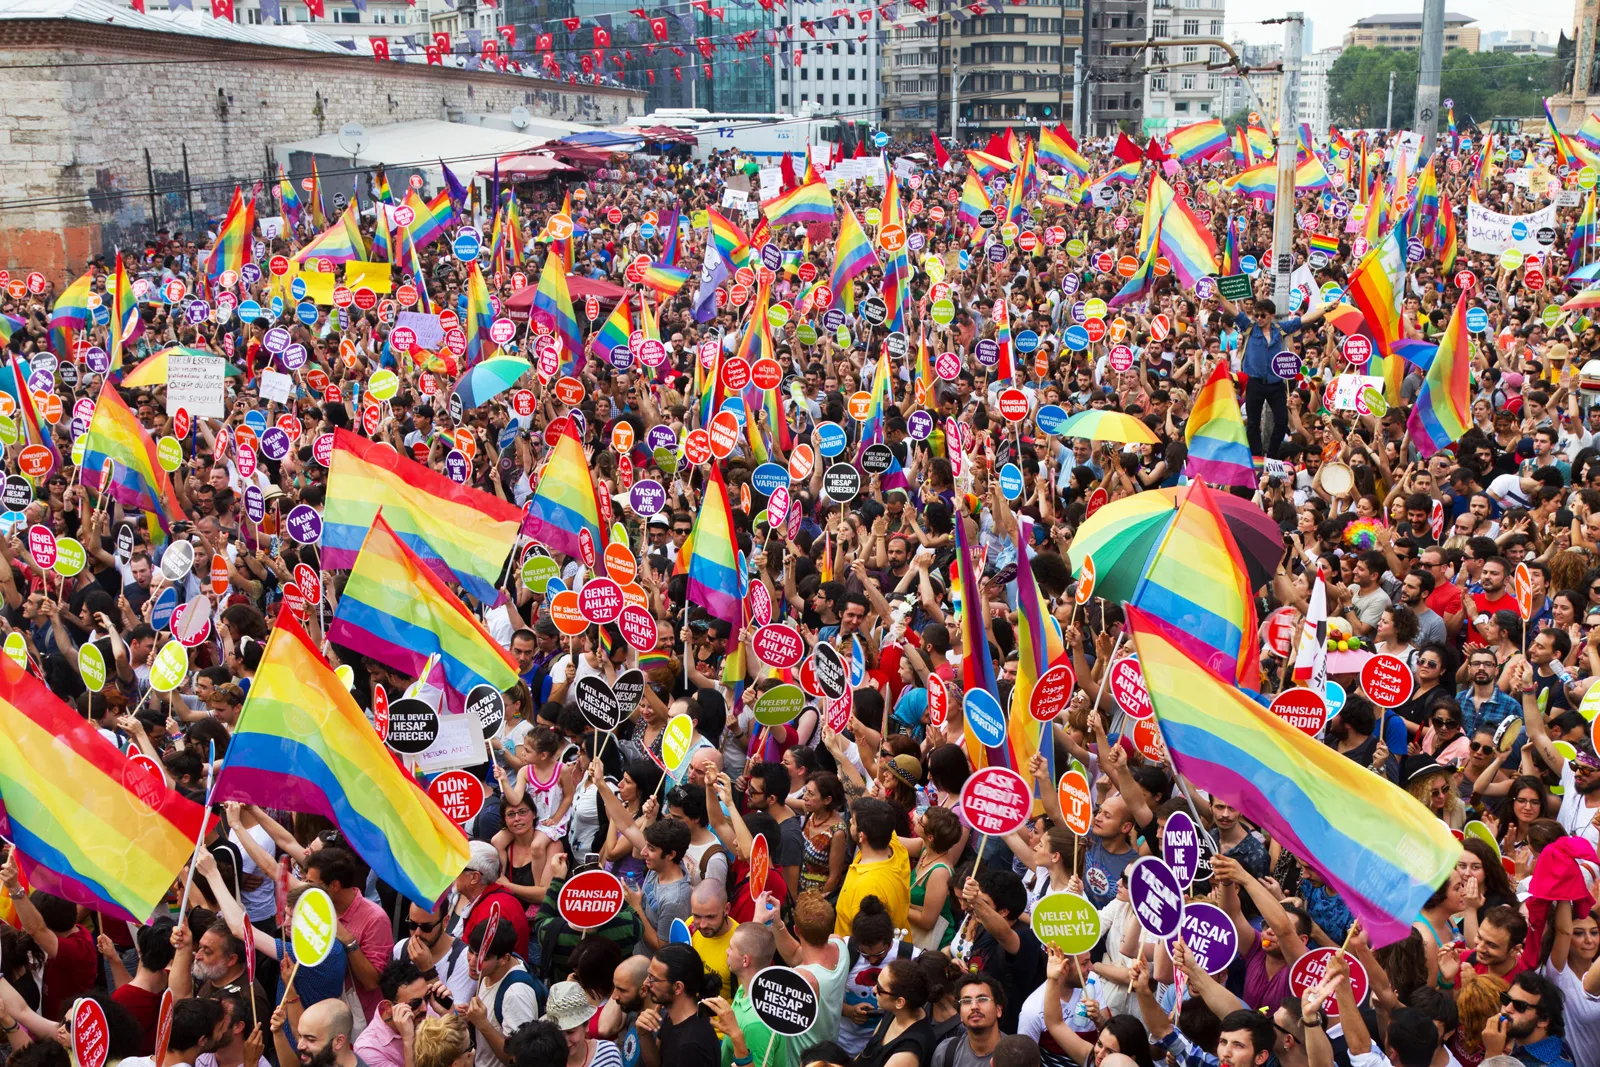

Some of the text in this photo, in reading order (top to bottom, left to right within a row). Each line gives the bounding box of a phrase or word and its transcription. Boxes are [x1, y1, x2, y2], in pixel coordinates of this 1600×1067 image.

[718, 128, 734, 138] T2
[652, 430, 674, 442] YASAK
[712, 421, 737, 438] TRANSLAR
[264, 431, 284, 445] YASAK
[711, 430, 735, 450] VARDIR
[273, 448, 285, 458] AYOL
[635, 488, 661, 497] YASAK
[289, 511, 315, 527] YASAK
[301, 523, 310, 533] NE
[32, 532, 51, 541] GENEL
[302, 532, 318, 541] AYOL
[33, 543, 54, 552] AHLAK-
[37, 555, 50, 564] SIZ!
[584, 586, 617, 599] GENEL
[585, 596, 620, 610] AHLAK-
[592, 609, 612, 619] SIZ!
[624, 612, 651, 628] GENEL
[624, 622, 654, 640] AHLAK-
[630, 635, 647, 648] SIZ!
[763, 629, 796, 649] GENEL
[758, 638, 797, 658] AHLAK-
[763, 650, 784, 664] SIZ!
[1378, 657, 1401, 672] المثلية
[1374, 668, 1401, 684] موجودة
[580, 681, 616, 708] KATİL POLİS
[584, 690, 610, 712] HESAP
[616, 691, 636, 701] HESAP
[1120, 692, 1141, 714] SIZ!
[1274, 705, 1322, 715] TRANSLAR
[580, 697, 614, 726] VERECEK!
[394, 722, 426, 730] HESAP
[970, 710, 999, 738] VARDIR
[388, 731, 434, 740] VERECEK!
[437, 778, 473, 793] DÖN-
[443, 794, 469, 806] ME-
[442, 806, 470, 820] YİZ!
[1166, 830, 1193, 847] YASAK
[1174, 850, 1185, 864] NE
[566, 889, 618, 899] TRANSLAR
[1140, 864, 1180, 911] YASAK
[565, 900, 615, 912] VARDIR
[1146, 889, 1164, 913] NE
[1040, 908, 1088, 921] VELEV Kİ
[1138, 904, 1162, 934] AYOL
[1039, 922, 1096, 937] İBNEYİZ
[1181, 912, 1231, 945] YASAK
[1188, 936, 1210, 955] NE
[758, 977, 812, 1003] KATİL POLİS
[764, 991, 803, 1010] HESAP
[755, 1000, 808, 1028] VERECEK!
